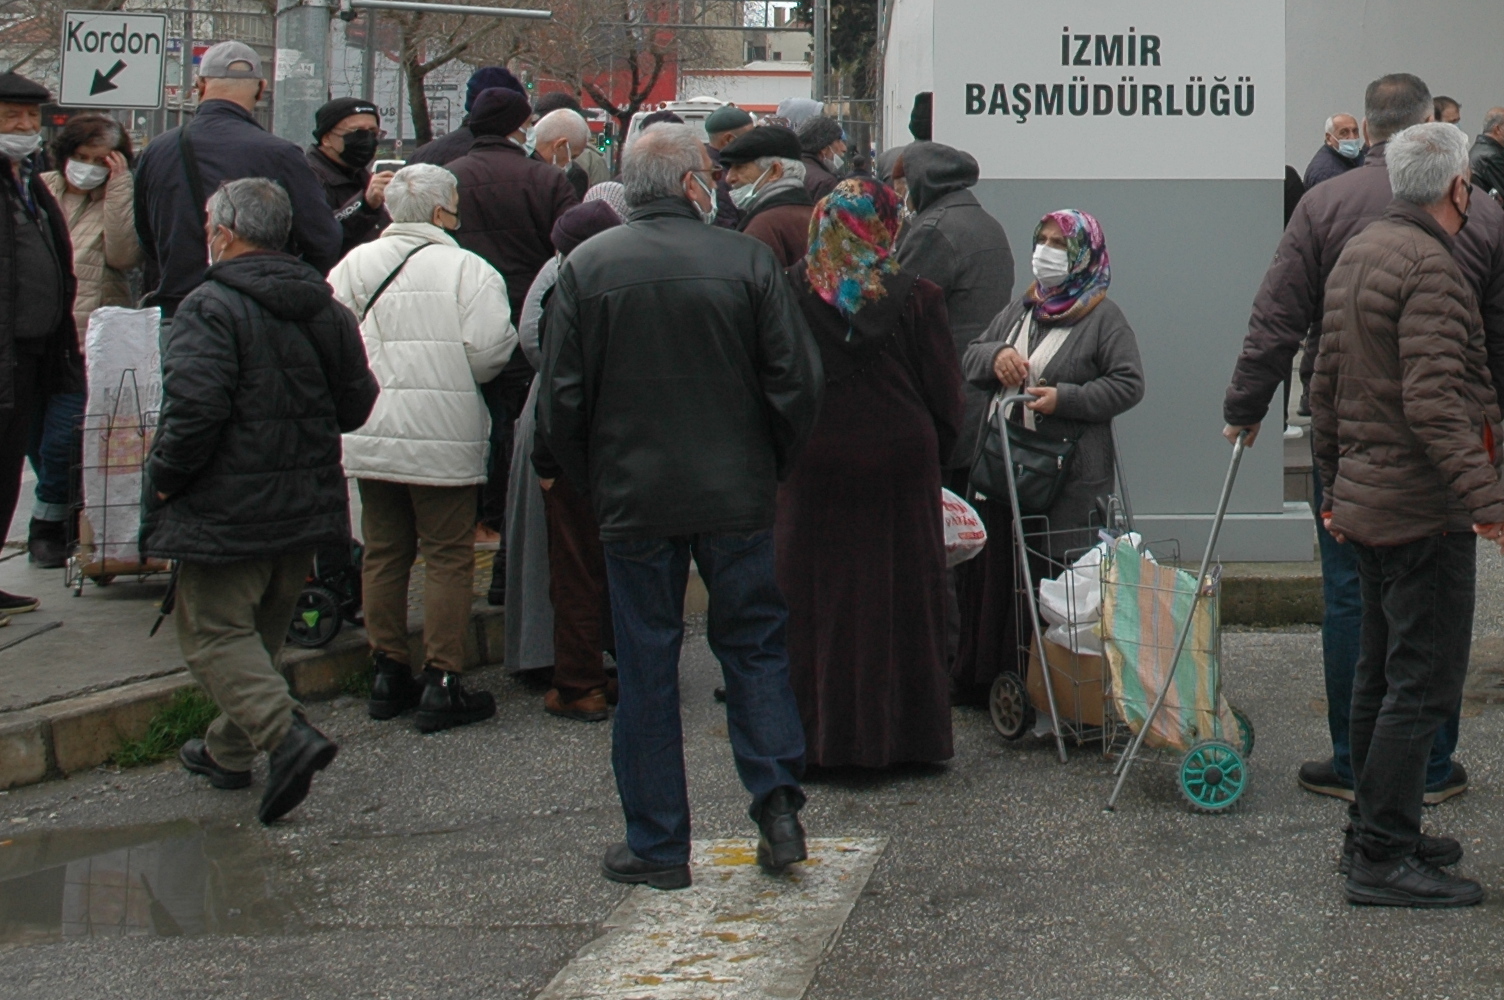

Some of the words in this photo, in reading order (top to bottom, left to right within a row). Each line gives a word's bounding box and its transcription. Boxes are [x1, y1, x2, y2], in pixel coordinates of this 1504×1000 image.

[66, 21, 161, 55] Kordon
[1061, 26, 1162, 67] İZMİR
[965, 75, 1256, 124] BAŞMÜDÜRLÜĞÜ
